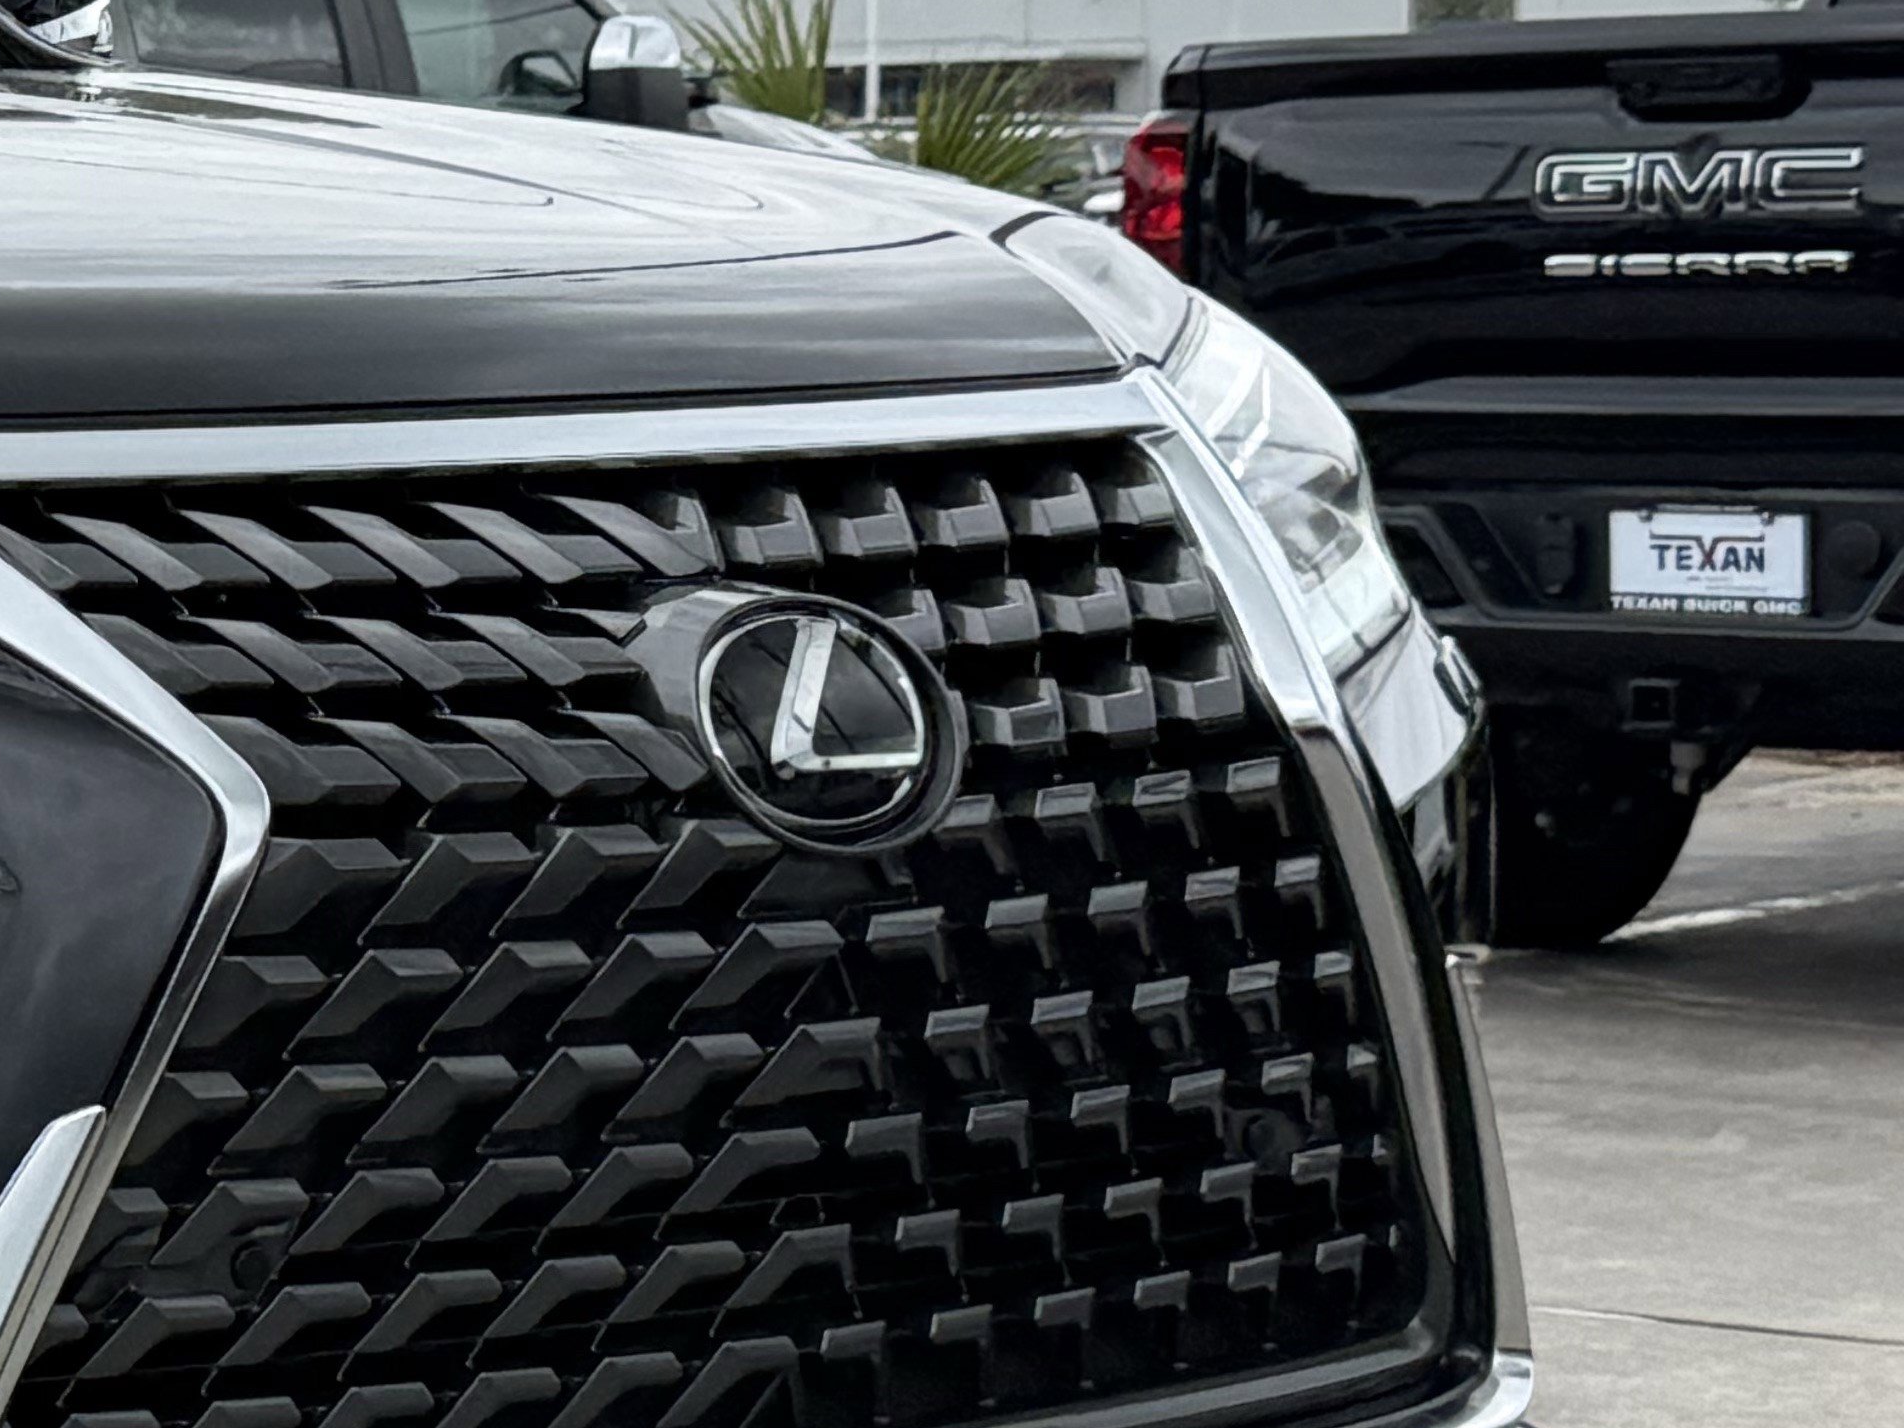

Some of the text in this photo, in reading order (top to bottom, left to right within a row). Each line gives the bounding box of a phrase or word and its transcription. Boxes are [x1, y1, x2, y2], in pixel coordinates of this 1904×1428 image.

[1535, 146, 1864, 215] GMC
[1649, 532, 1766, 574] TEXAN
[1610, 595, 1678, 612] TEXAN
